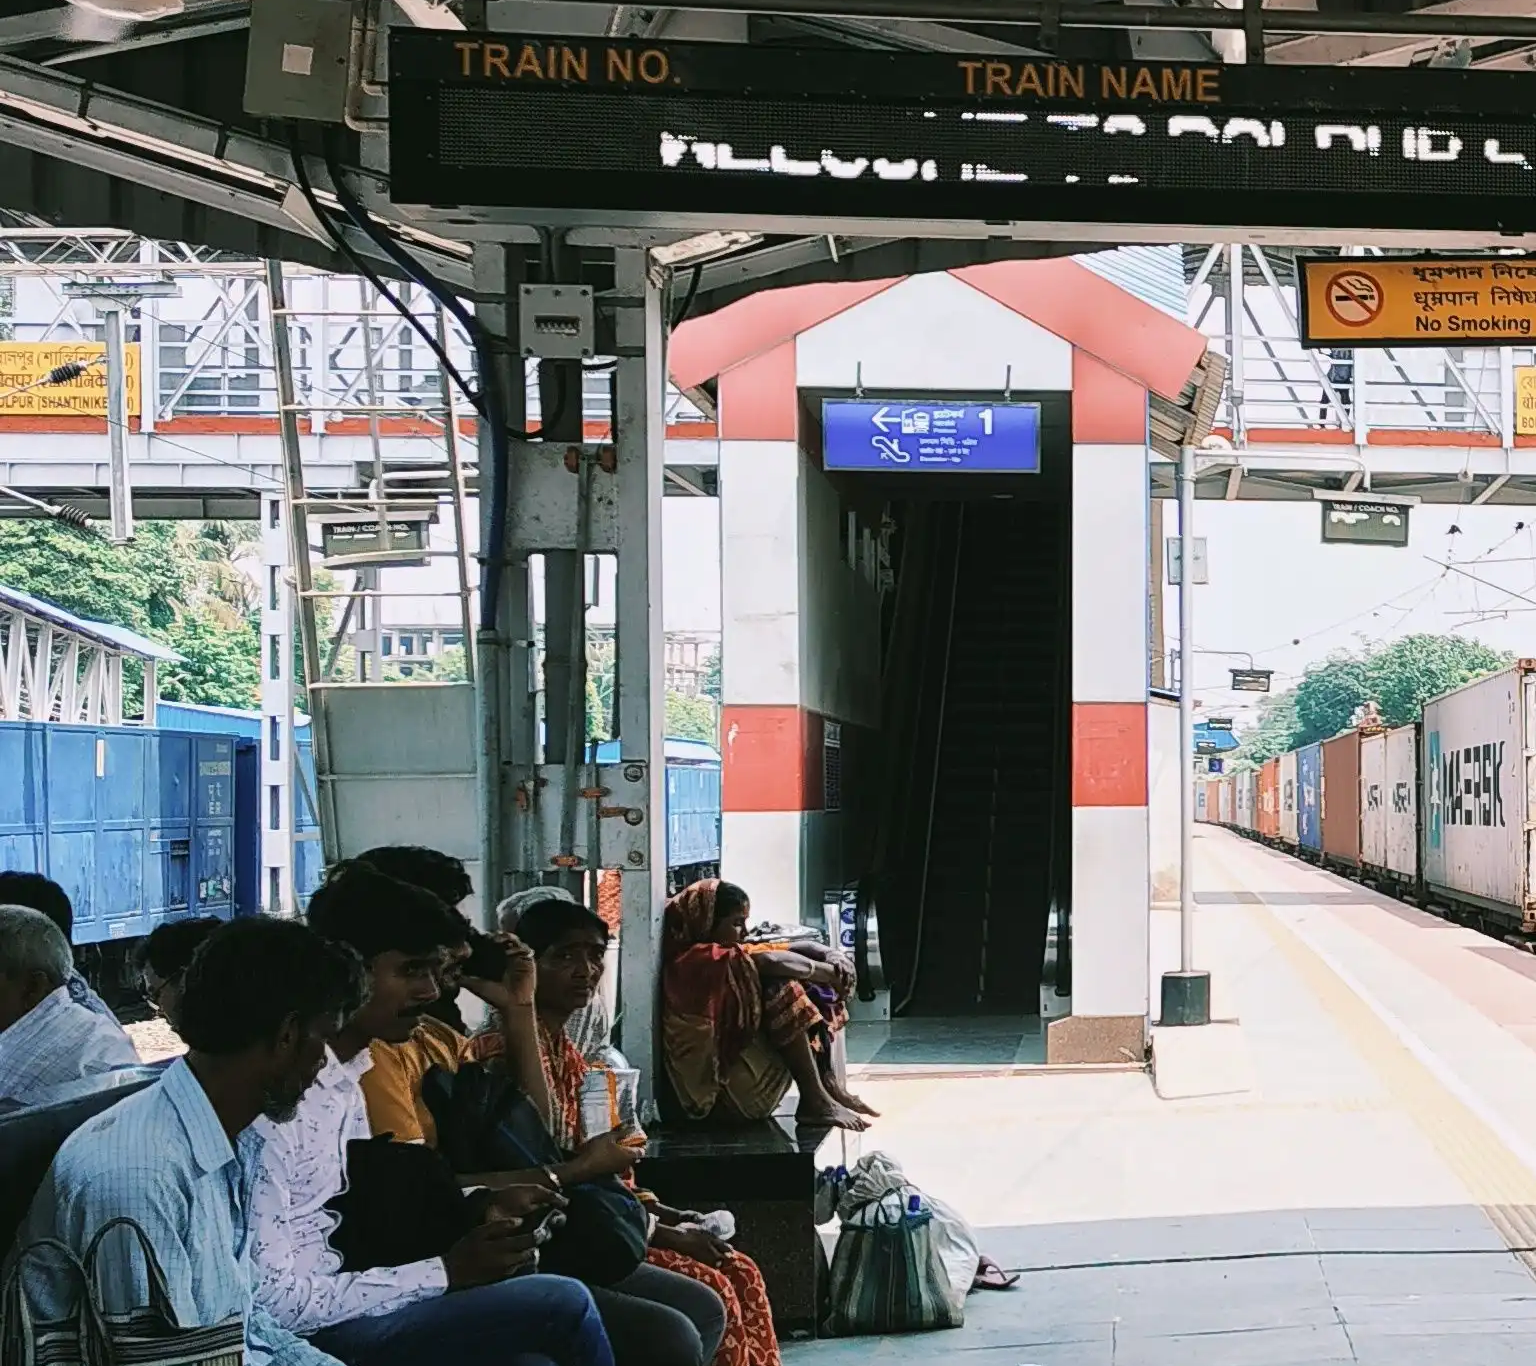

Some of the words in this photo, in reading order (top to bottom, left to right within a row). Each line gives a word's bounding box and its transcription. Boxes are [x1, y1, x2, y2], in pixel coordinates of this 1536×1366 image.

[454, 42, 587, 81] TRAIN
[607, 47, 681, 84] NO.
[958, 61, 1084, 99] TRAIN
[1101, 66, 1221, 102] NAME
[1415, 315, 1442, 332] No
[1447, 315, 1531, 335] Smoking
[978, 408, 993, 435] 1
[1443, 740, 1506, 828] MAERSK
